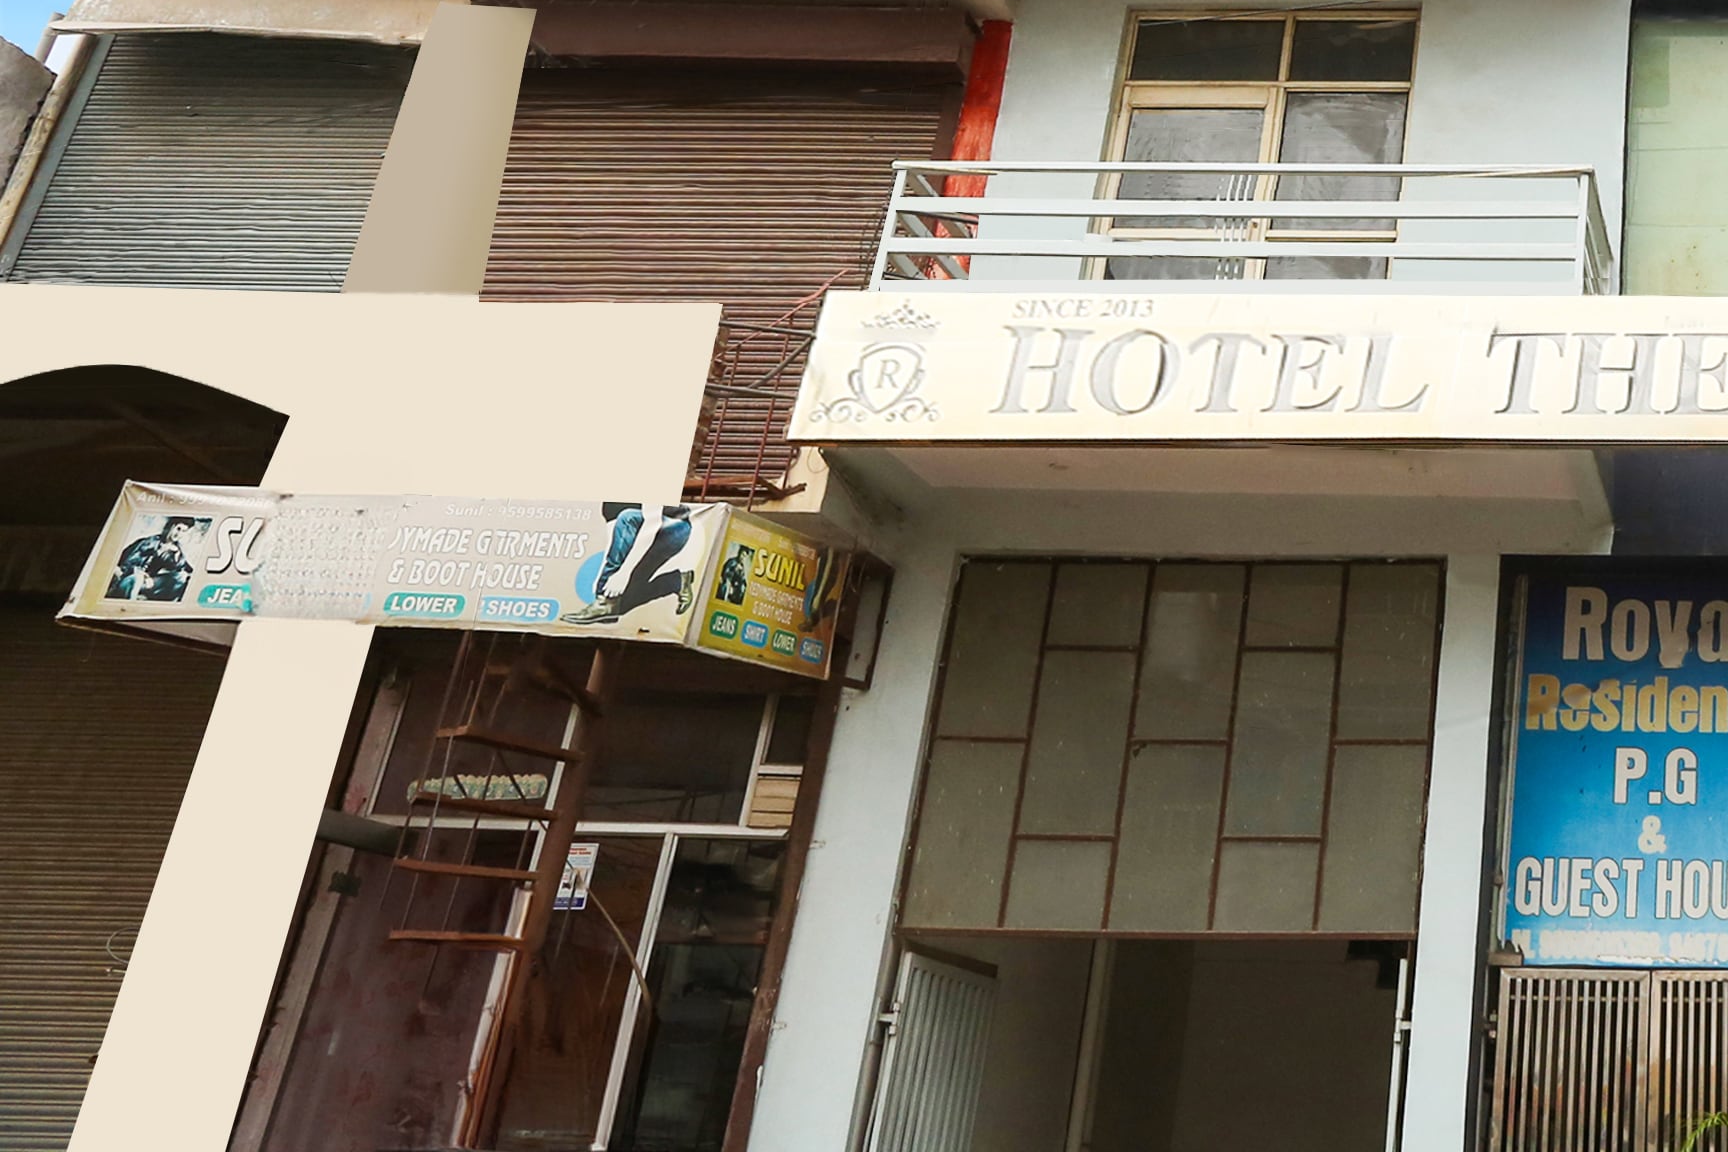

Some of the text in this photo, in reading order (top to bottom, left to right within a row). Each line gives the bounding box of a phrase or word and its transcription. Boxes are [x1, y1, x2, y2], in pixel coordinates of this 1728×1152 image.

[1012, 299, 1155, 318] SINCE 2013
[876, 358, 901, 389] R
[988, 325, 1430, 415] HOTEL
[407, 560, 470, 587] BOOT
[470, 562, 543, 590] HOUSE
[754, 548, 806, 592] SUNIL
[390, 596, 458, 614] LOWER
[486, 602, 551, 618] SHOES
[712, 615, 737, 635] JEANS
[773, 632, 795, 652] LOWER
[1613, 746, 1698, 805] P.G
[1637, 815, 1667, 854] &
[1514, 856, 1644, 918] GUEST
